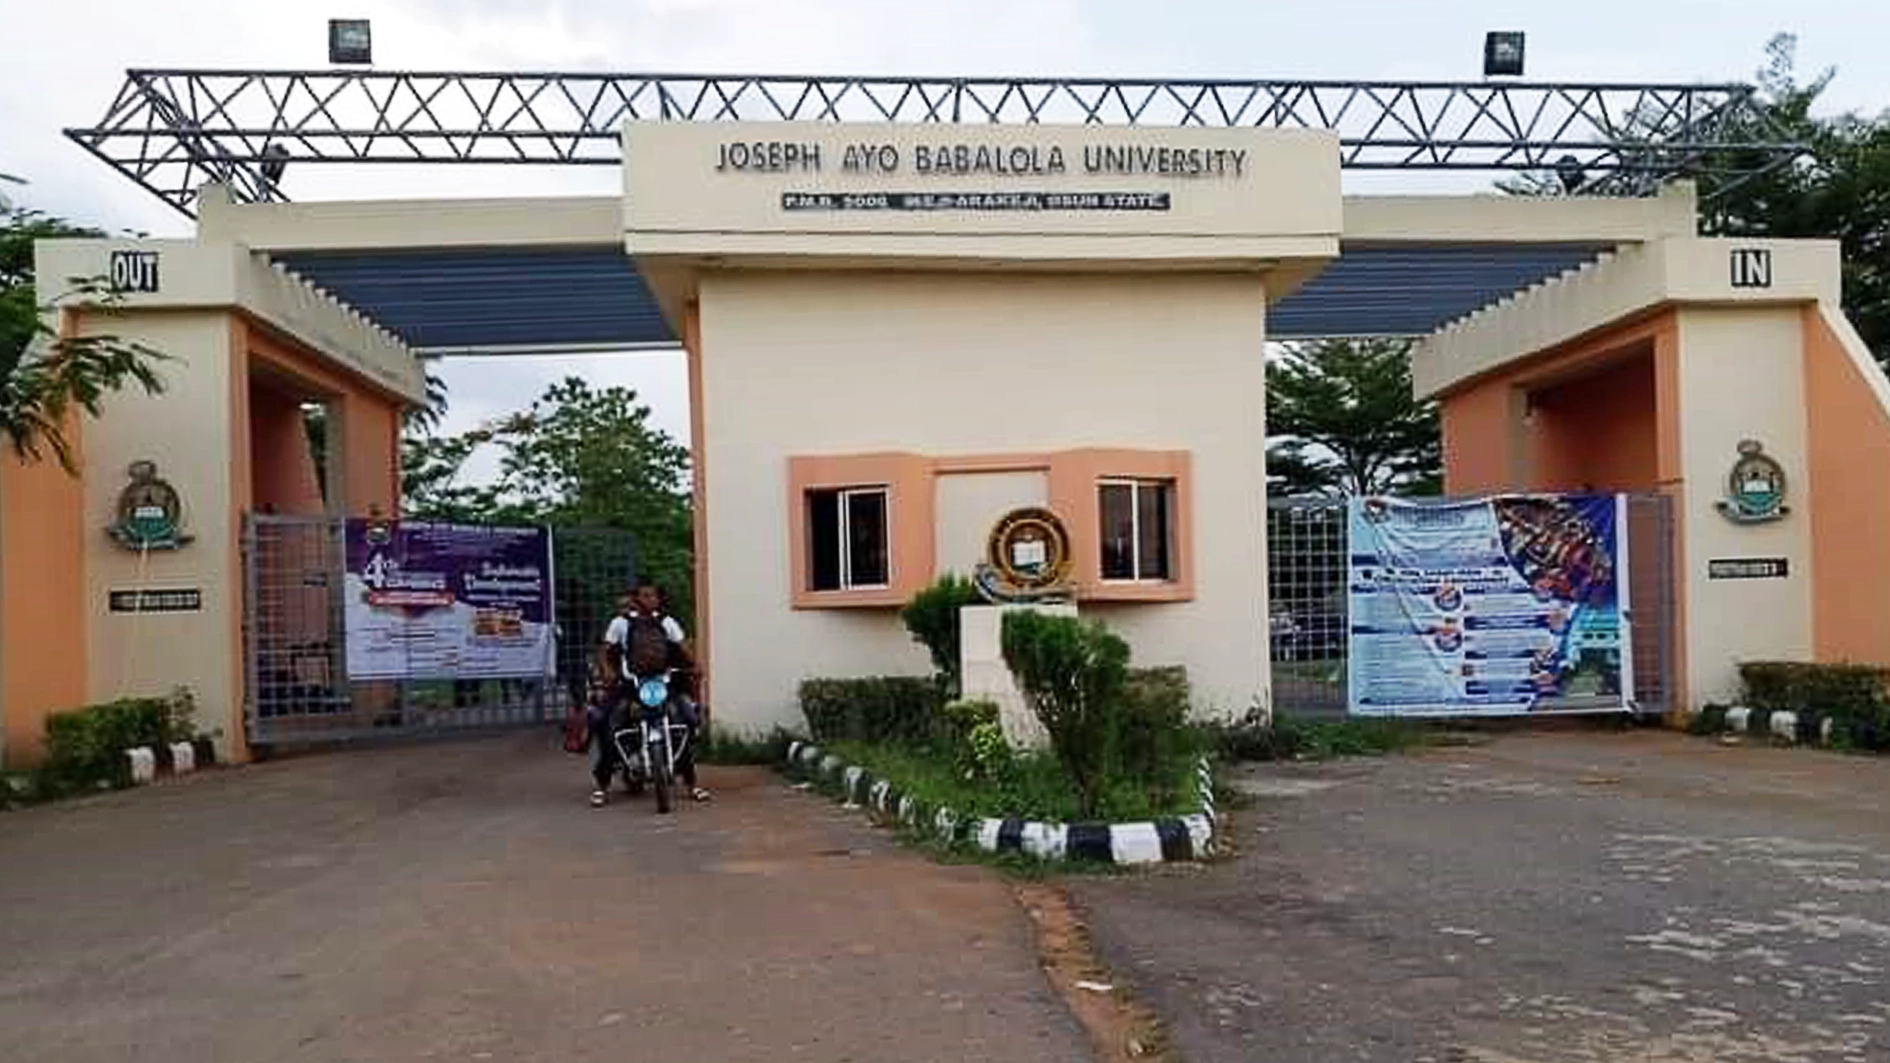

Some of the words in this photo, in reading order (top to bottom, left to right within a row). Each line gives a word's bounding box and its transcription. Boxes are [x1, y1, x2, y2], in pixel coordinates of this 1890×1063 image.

[715, 143, 821, 171] JOSEPH
[843, 144, 899, 172] AYO
[915, 145, 1066, 173] BABALOLA
[1084, 145, 1246, 175] UNIVERSITY
[113, 254, 156, 289] OUT
[1735, 252, 1767, 284] IN
